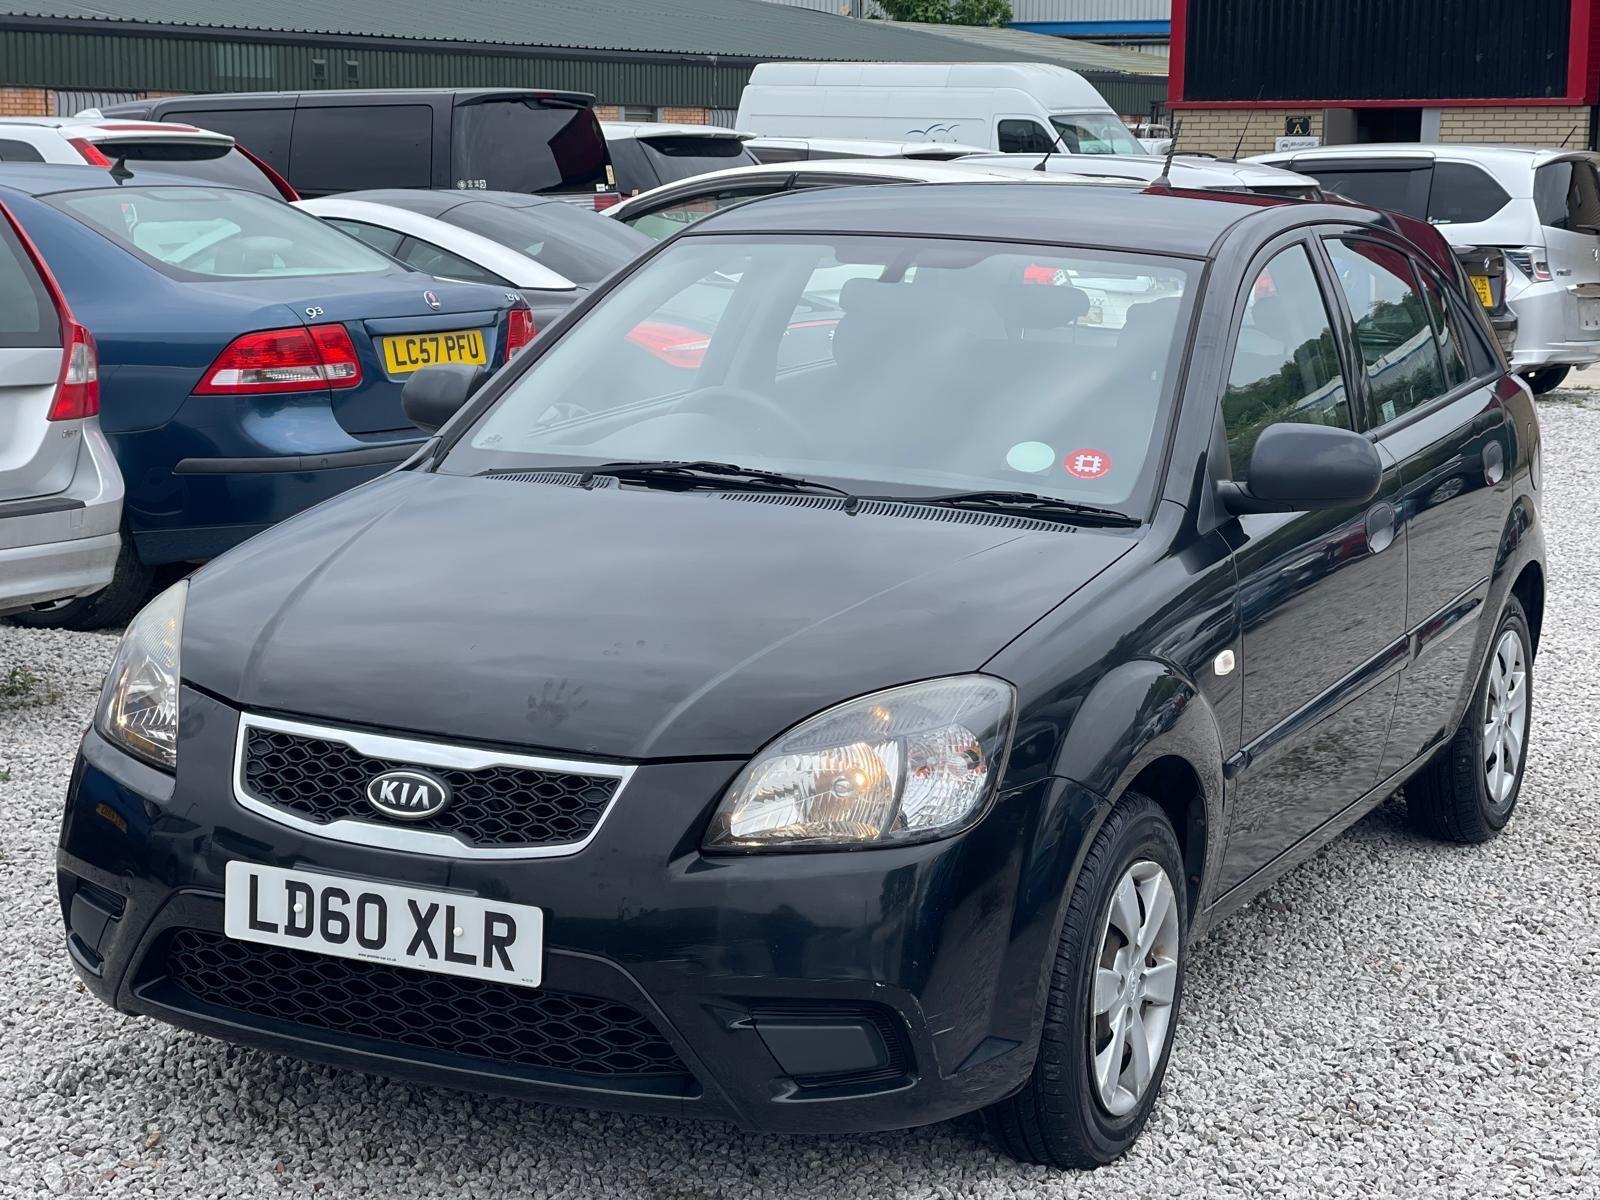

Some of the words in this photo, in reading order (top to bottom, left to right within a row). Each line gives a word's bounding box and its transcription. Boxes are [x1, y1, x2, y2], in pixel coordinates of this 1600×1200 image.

[1293, 123, 1303, 134] A
[392, 335, 440, 367] LC57
[444, 332, 480, 362] PFU
[378, 779, 430, 809] KIA
[248, 873, 388, 951] LD60
[405, 898, 518, 972] XLR
